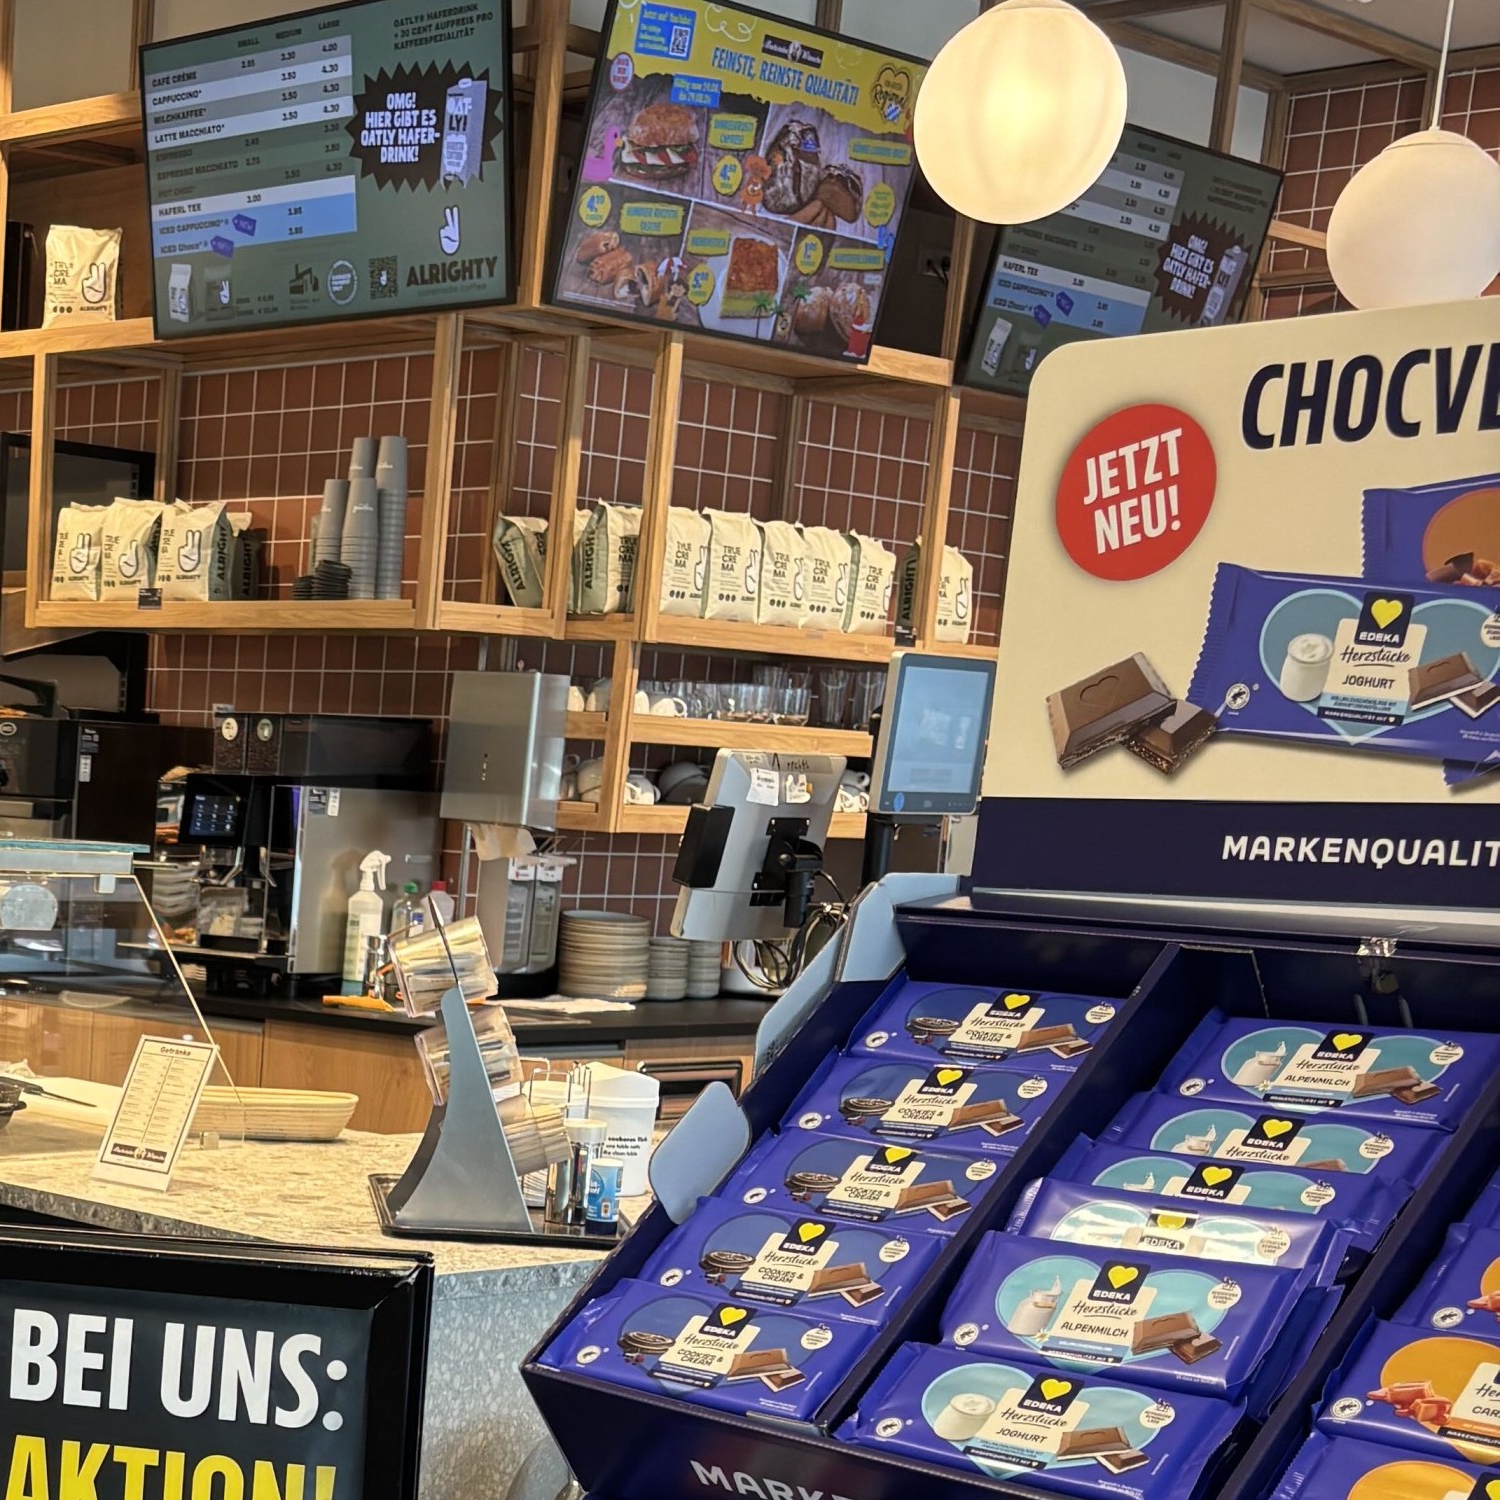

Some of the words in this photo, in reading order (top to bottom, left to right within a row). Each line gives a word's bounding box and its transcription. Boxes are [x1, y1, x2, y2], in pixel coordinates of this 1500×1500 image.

[758, 60, 804, 91] REINSTE
[386, 91, 417, 110] OMG!
[365, 111, 392, 129] HIER
[393, 110, 420, 128] GIBT
[421, 109, 437, 127] ES
[154, 130, 178, 144] LATTE
[360, 129, 397, 147] OATLY
[397, 127, 441, 145] HAFER-
[380, 145, 419, 164] DRINK!
[405, 255, 499, 288] ALRIGHTY
[1083, 427, 1183, 506] JETZT
[1093, 485, 1182, 555] NEU!
[721, 554, 738, 564] CRE
[721, 563, 736, 572] MA
[1358, 631, 1400, 644] EDEKA
[1339, 645, 1411, 664] Herzstücke
[1341, 674, 1396, 690] JOGHURT
[1092, 1289, 1131, 1301] EDEKA
[1072, 1300, 1138, 1317] Herzstücke
[1060, 1321, 1130, 1339] ALPENMILCH
[10, 1309, 133, 1410] BEI
[161, 1322, 347, 1431] UNS:
